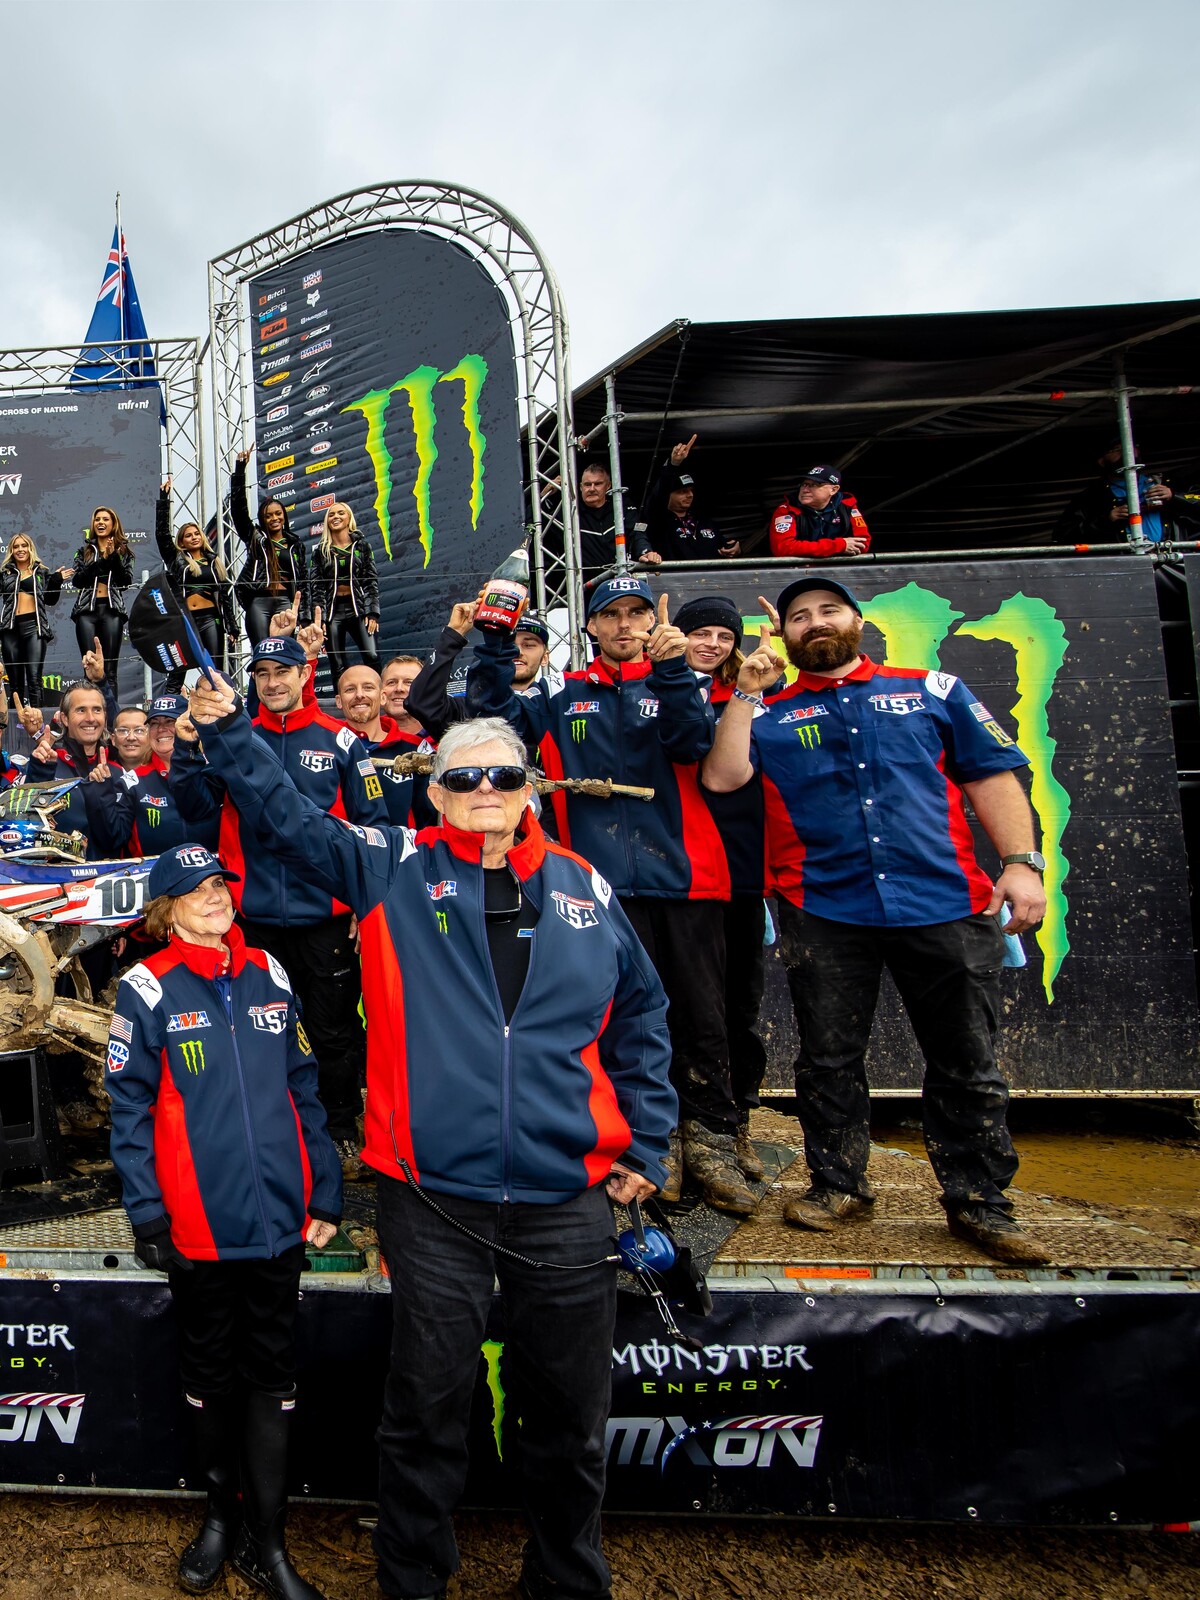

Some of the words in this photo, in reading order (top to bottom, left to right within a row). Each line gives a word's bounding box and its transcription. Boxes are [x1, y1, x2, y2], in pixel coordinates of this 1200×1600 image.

[303, 277, 322, 290] MOLY
[263, 322, 285, 337] KTM
[267, 355, 290, 370] THOR
[31, 407, 42, 415] OF
[43, 405, 79, 414] NATIONS
[263, 425, 293, 439] NAMURA
[306, 426, 333, 438] OAKLEY
[268, 441, 291, 456] FXR
[314, 444, 328, 452] BELL
[273, 489, 296, 500] ATHENA
[492, 612, 512, 623] PLACE
[259, 641, 284, 653] USA
[154, 700, 176, 710] USA
[564, 701, 600, 715] AMA
[874, 699, 925, 715] USA
[778, 704, 829, 724] AMA
[300, 754, 333, 773] USA
[140, 794, 168, 807] AMA
[180, 849, 214, 867] USA
[71, 868, 99, 877] YAMAHA
[95, 875, 152, 917] 101
[556, 899, 599, 929] USA
[166, 1011, 213, 1032] AMA
[253, 1010, 288, 1034] USA
[611, 1338, 814, 1376] MONSTER
[642, 1378, 782, 1394] ENERGY
